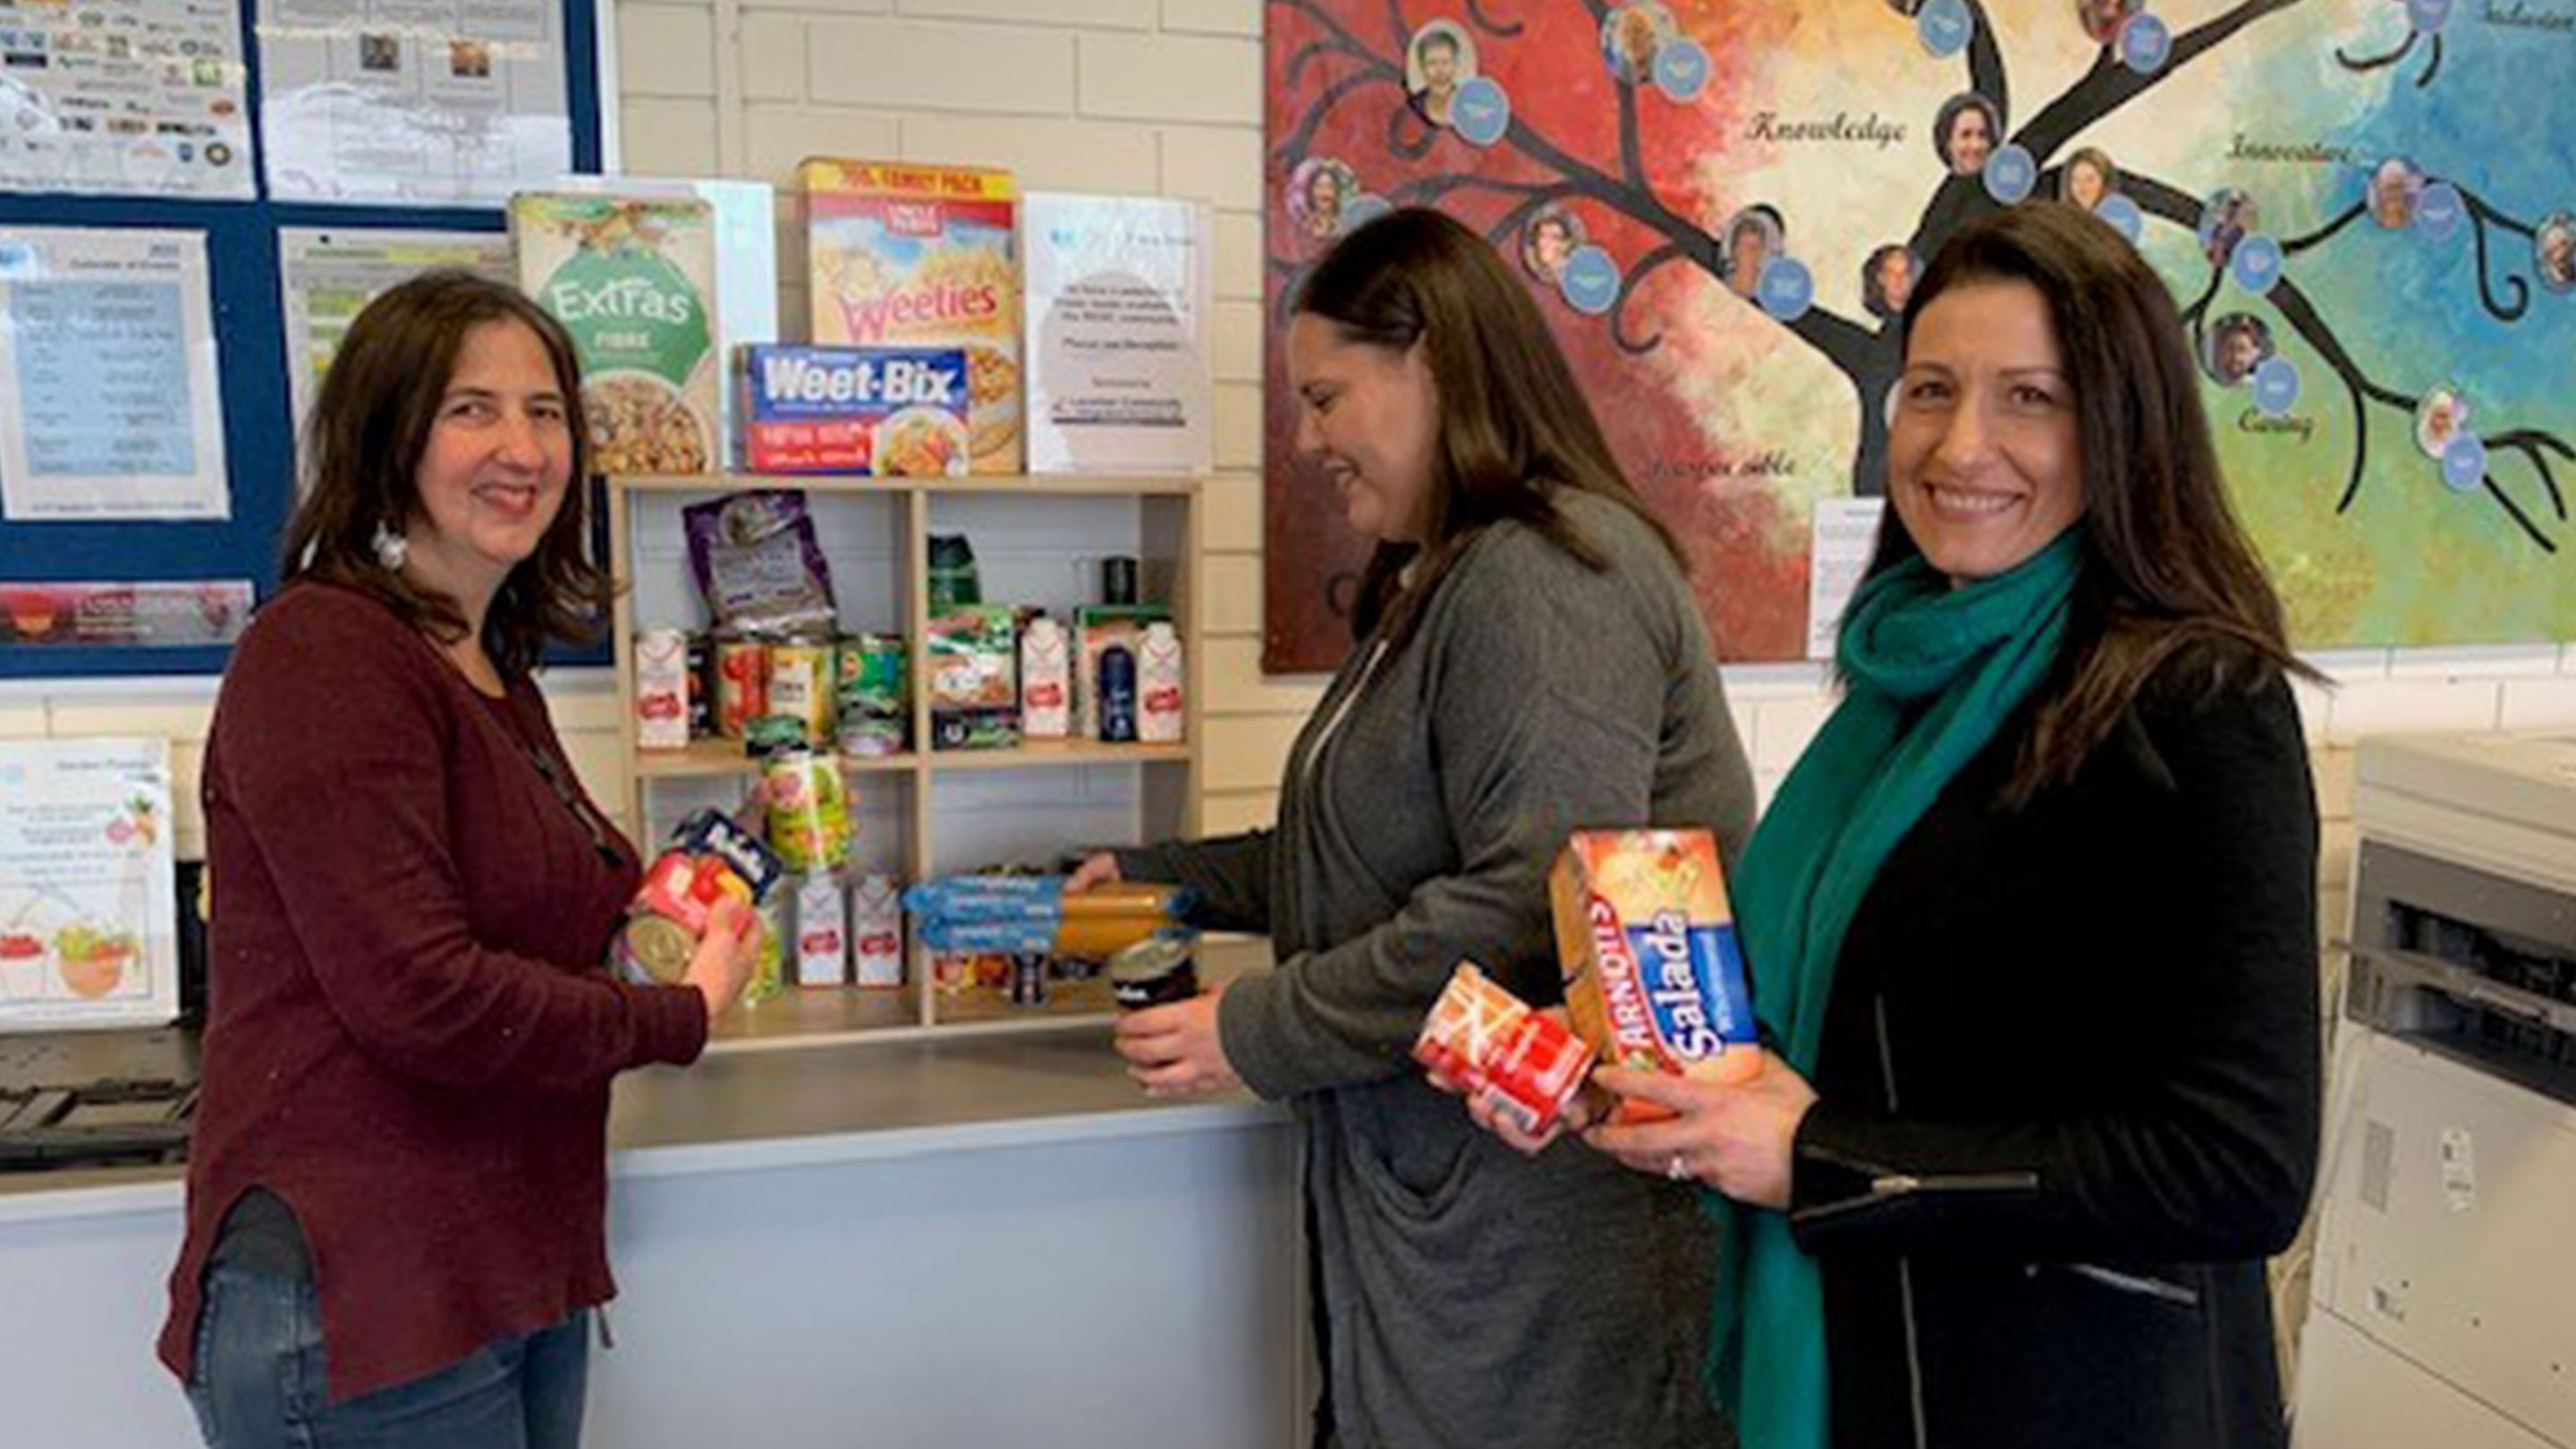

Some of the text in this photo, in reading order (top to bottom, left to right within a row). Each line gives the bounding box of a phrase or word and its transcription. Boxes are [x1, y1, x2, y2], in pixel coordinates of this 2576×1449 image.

[1745, 111, 1907, 150] Knowledge
[552, 276, 692, 326] Extras
[838, 278, 997, 343] Weeties
[763, 358, 957, 404] Weet-Bix
[1642, 909, 1726, 1062] Salada
